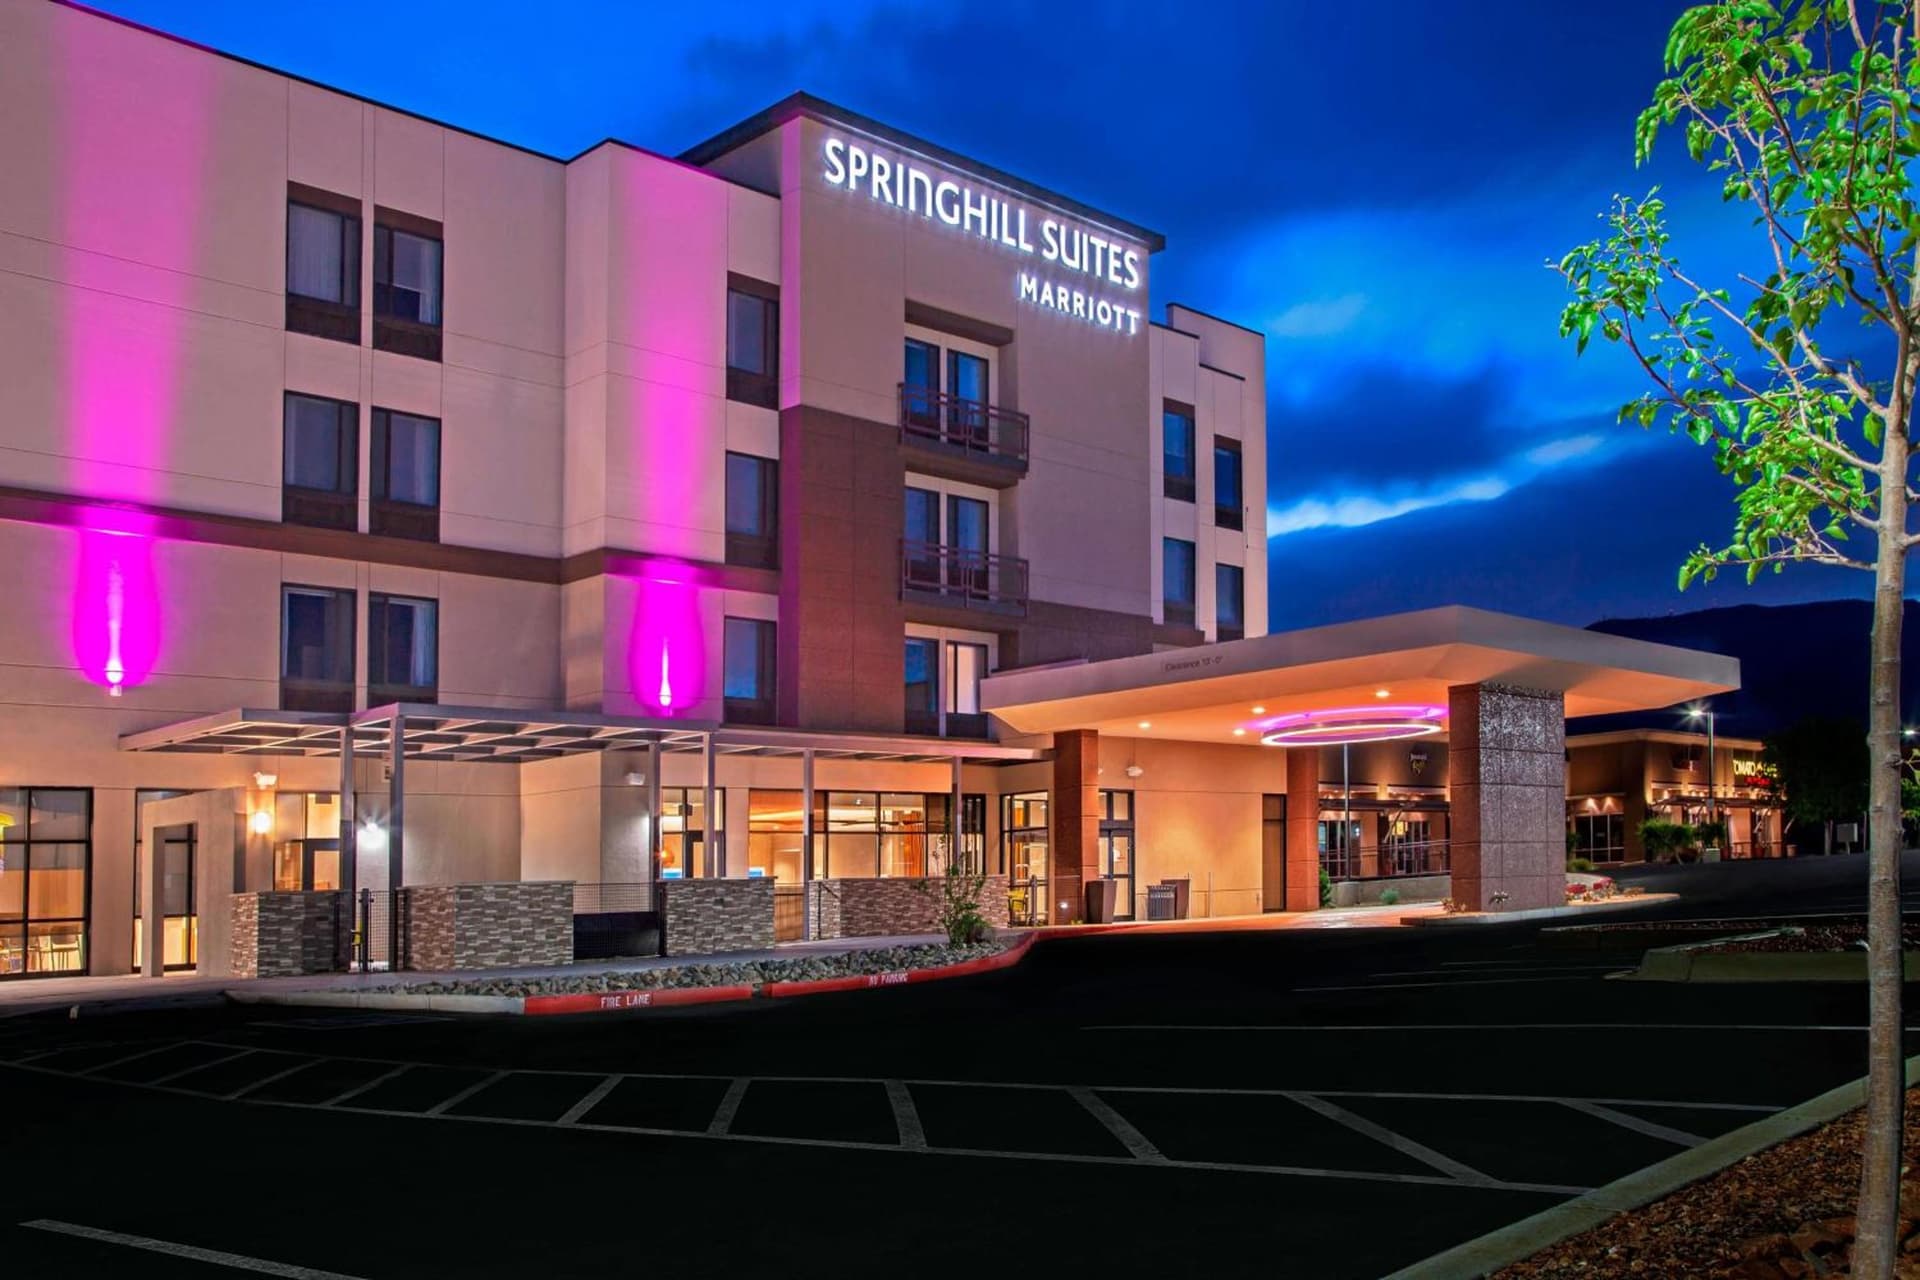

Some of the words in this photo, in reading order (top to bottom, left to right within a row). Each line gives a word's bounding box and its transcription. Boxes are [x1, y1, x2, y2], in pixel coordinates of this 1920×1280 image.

[824, 137, 1033, 253] SPRINGHILL
[1041, 219, 1139, 289] SUITES
[1020, 272, 1141, 335] MARRIOTT
[601, 996, 621, 1009] FIRE
[627, 993, 650, 1006] LANE
